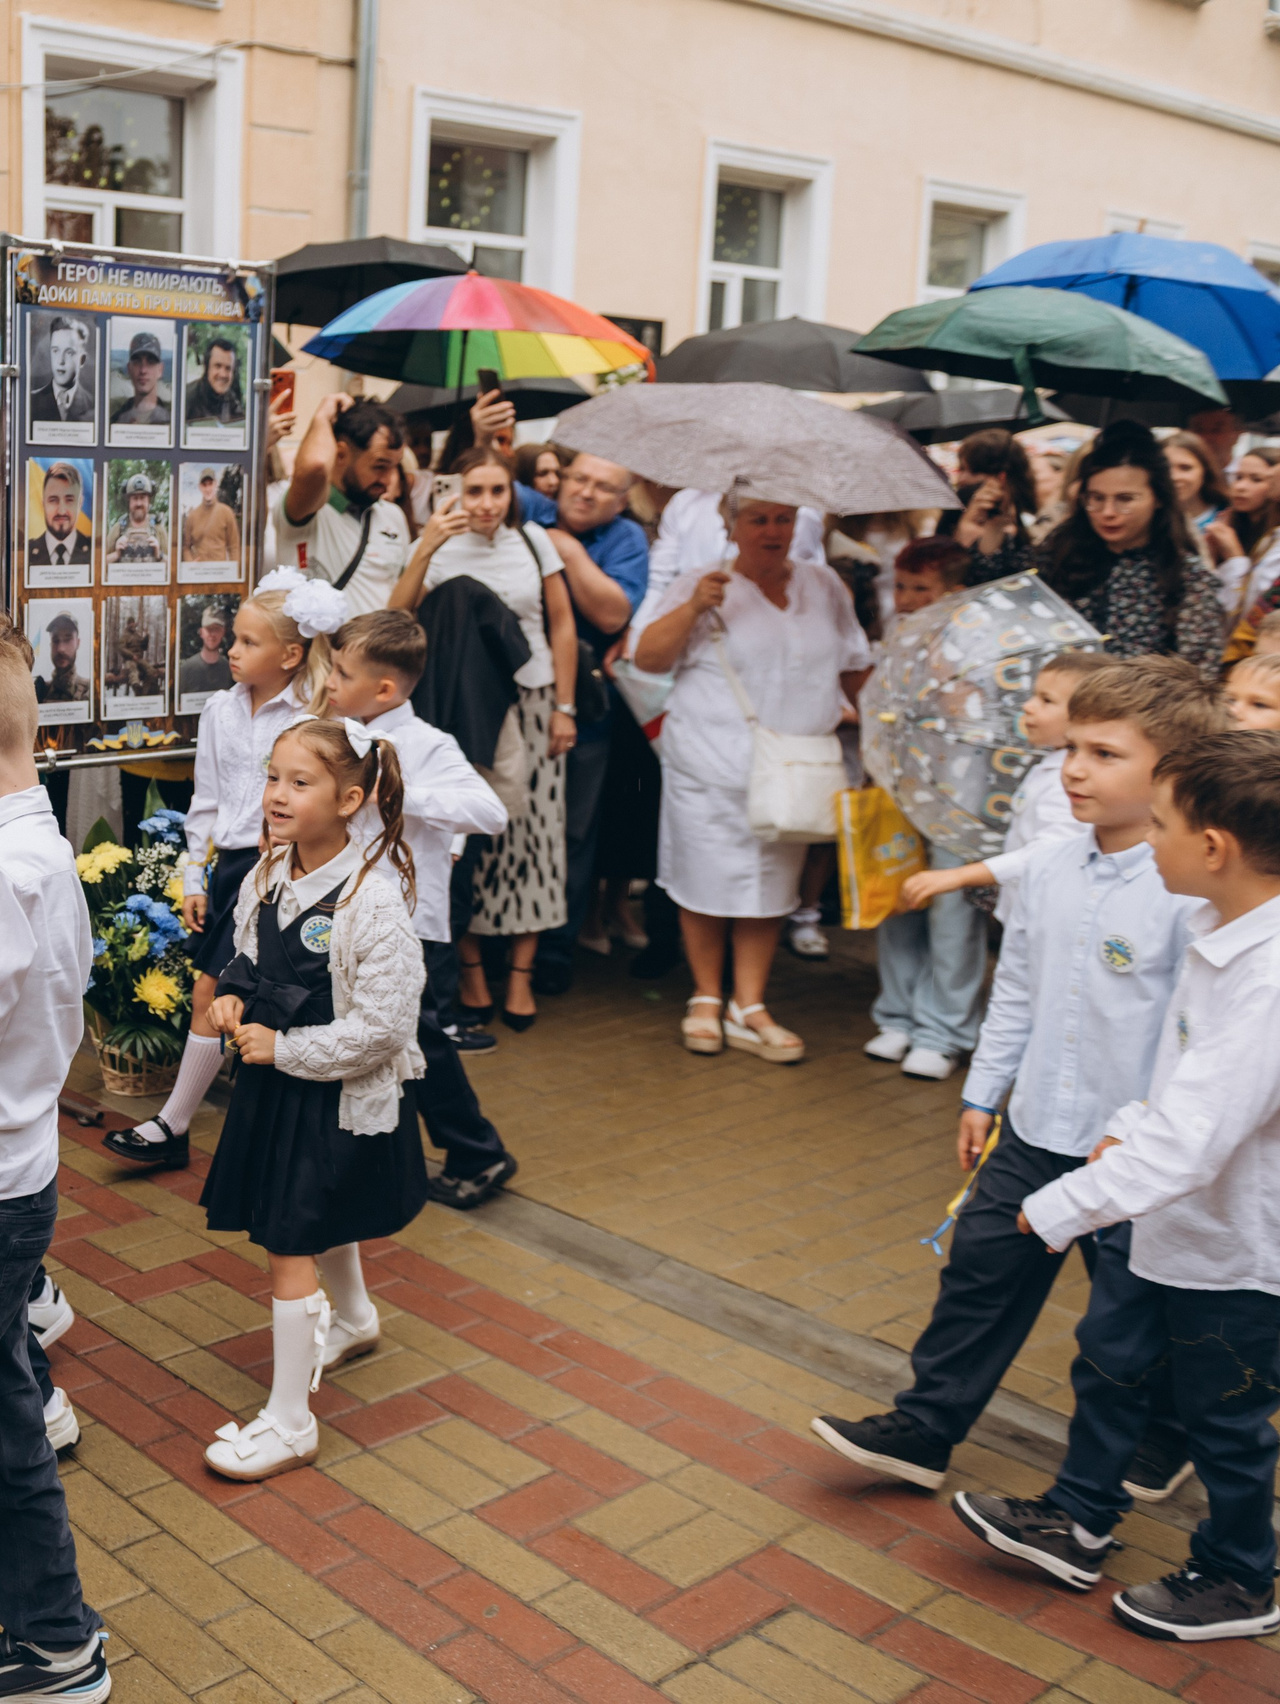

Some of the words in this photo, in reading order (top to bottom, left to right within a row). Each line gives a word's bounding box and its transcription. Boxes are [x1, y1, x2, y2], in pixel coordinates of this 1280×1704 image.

[57, 262, 106, 284] ГЕРОЇ
[108, 267, 131, 287] НЕ
[133, 270, 226, 297] ВМИРАЮТЬ,
[37, 284, 79, 304] ДОКИ
[143, 294, 171, 312] ПРО
[174, 297, 200, 314] НИХ
[203, 300, 243, 318] ЖИВА
